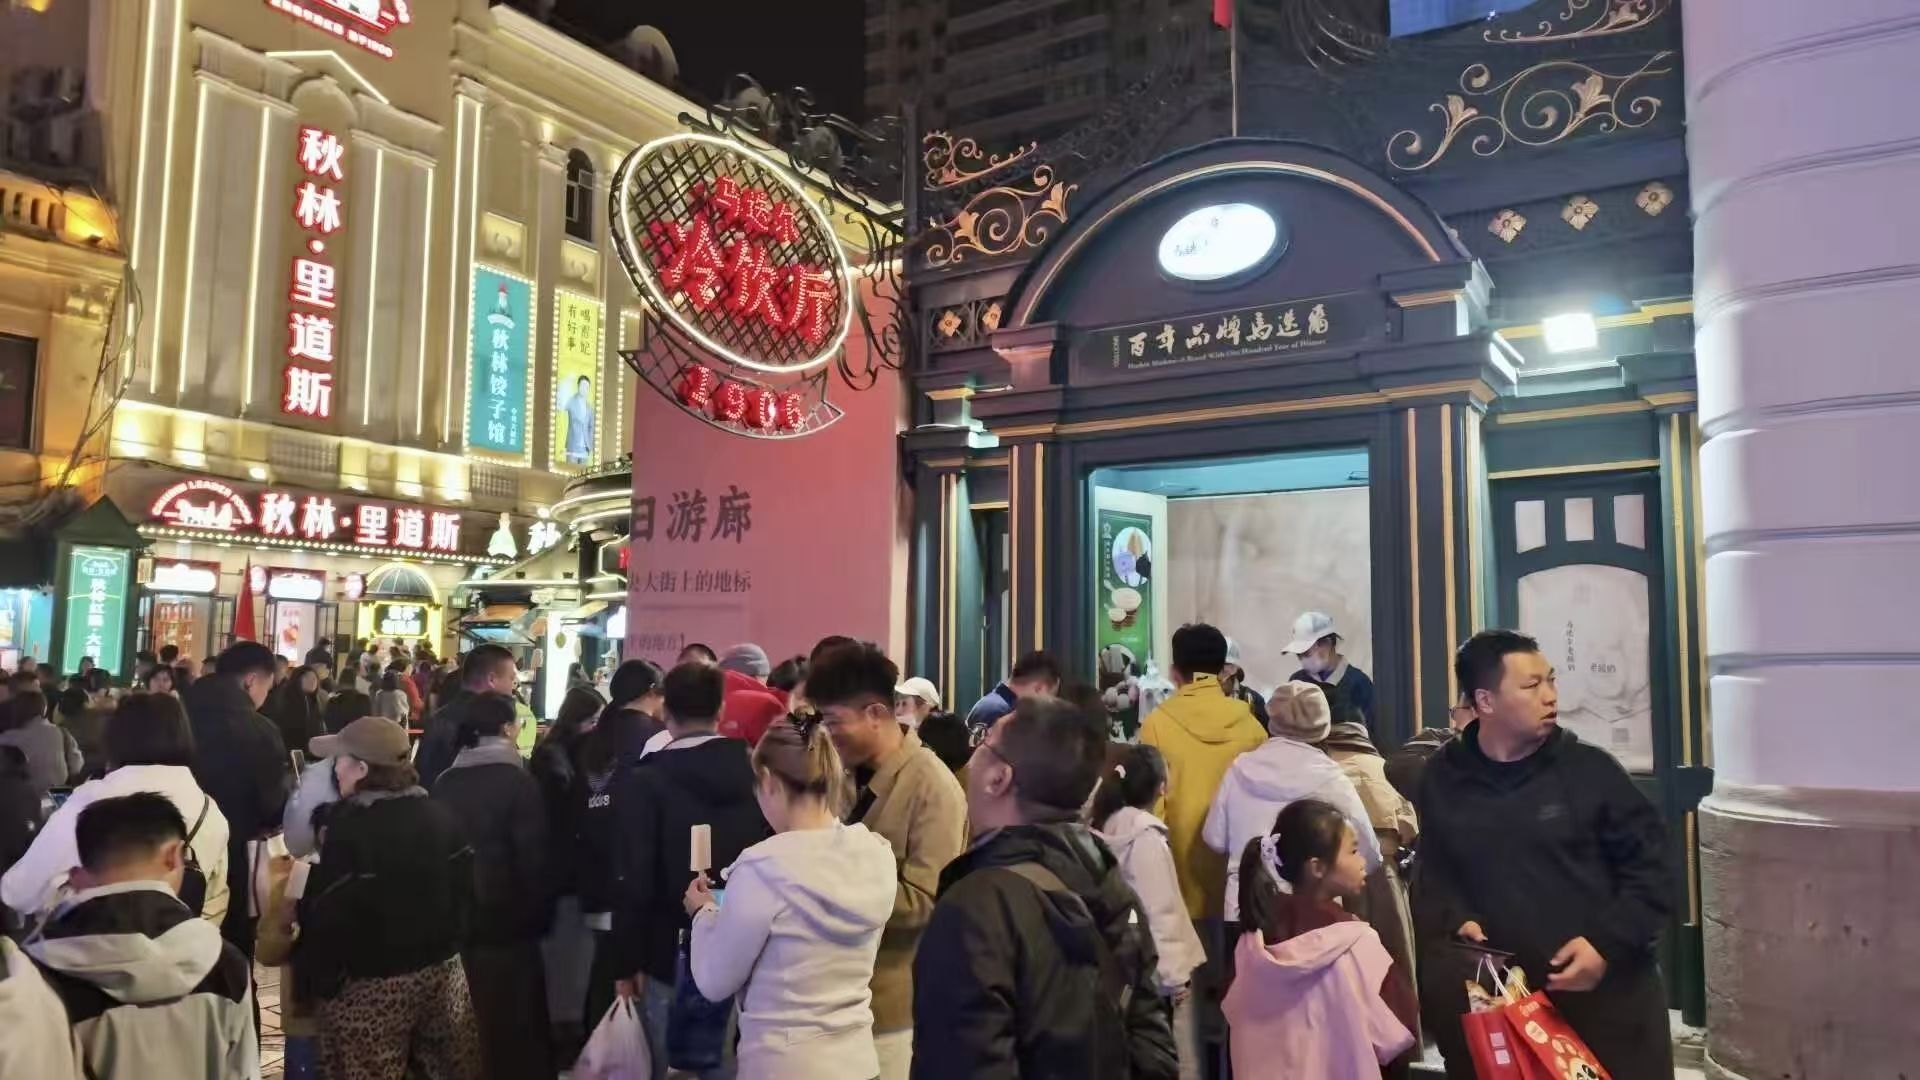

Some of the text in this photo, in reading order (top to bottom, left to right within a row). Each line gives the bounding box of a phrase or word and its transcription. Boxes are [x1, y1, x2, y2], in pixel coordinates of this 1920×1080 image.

[285, 127, 344, 418] 秋林·里道斯
[660, 212, 834, 342] 冷饮厅
[487, 328, 510, 443] 秋林饺子馆
[691, 365, 805, 433] 1906
[260, 493, 461, 551] 秋林·里道斯
